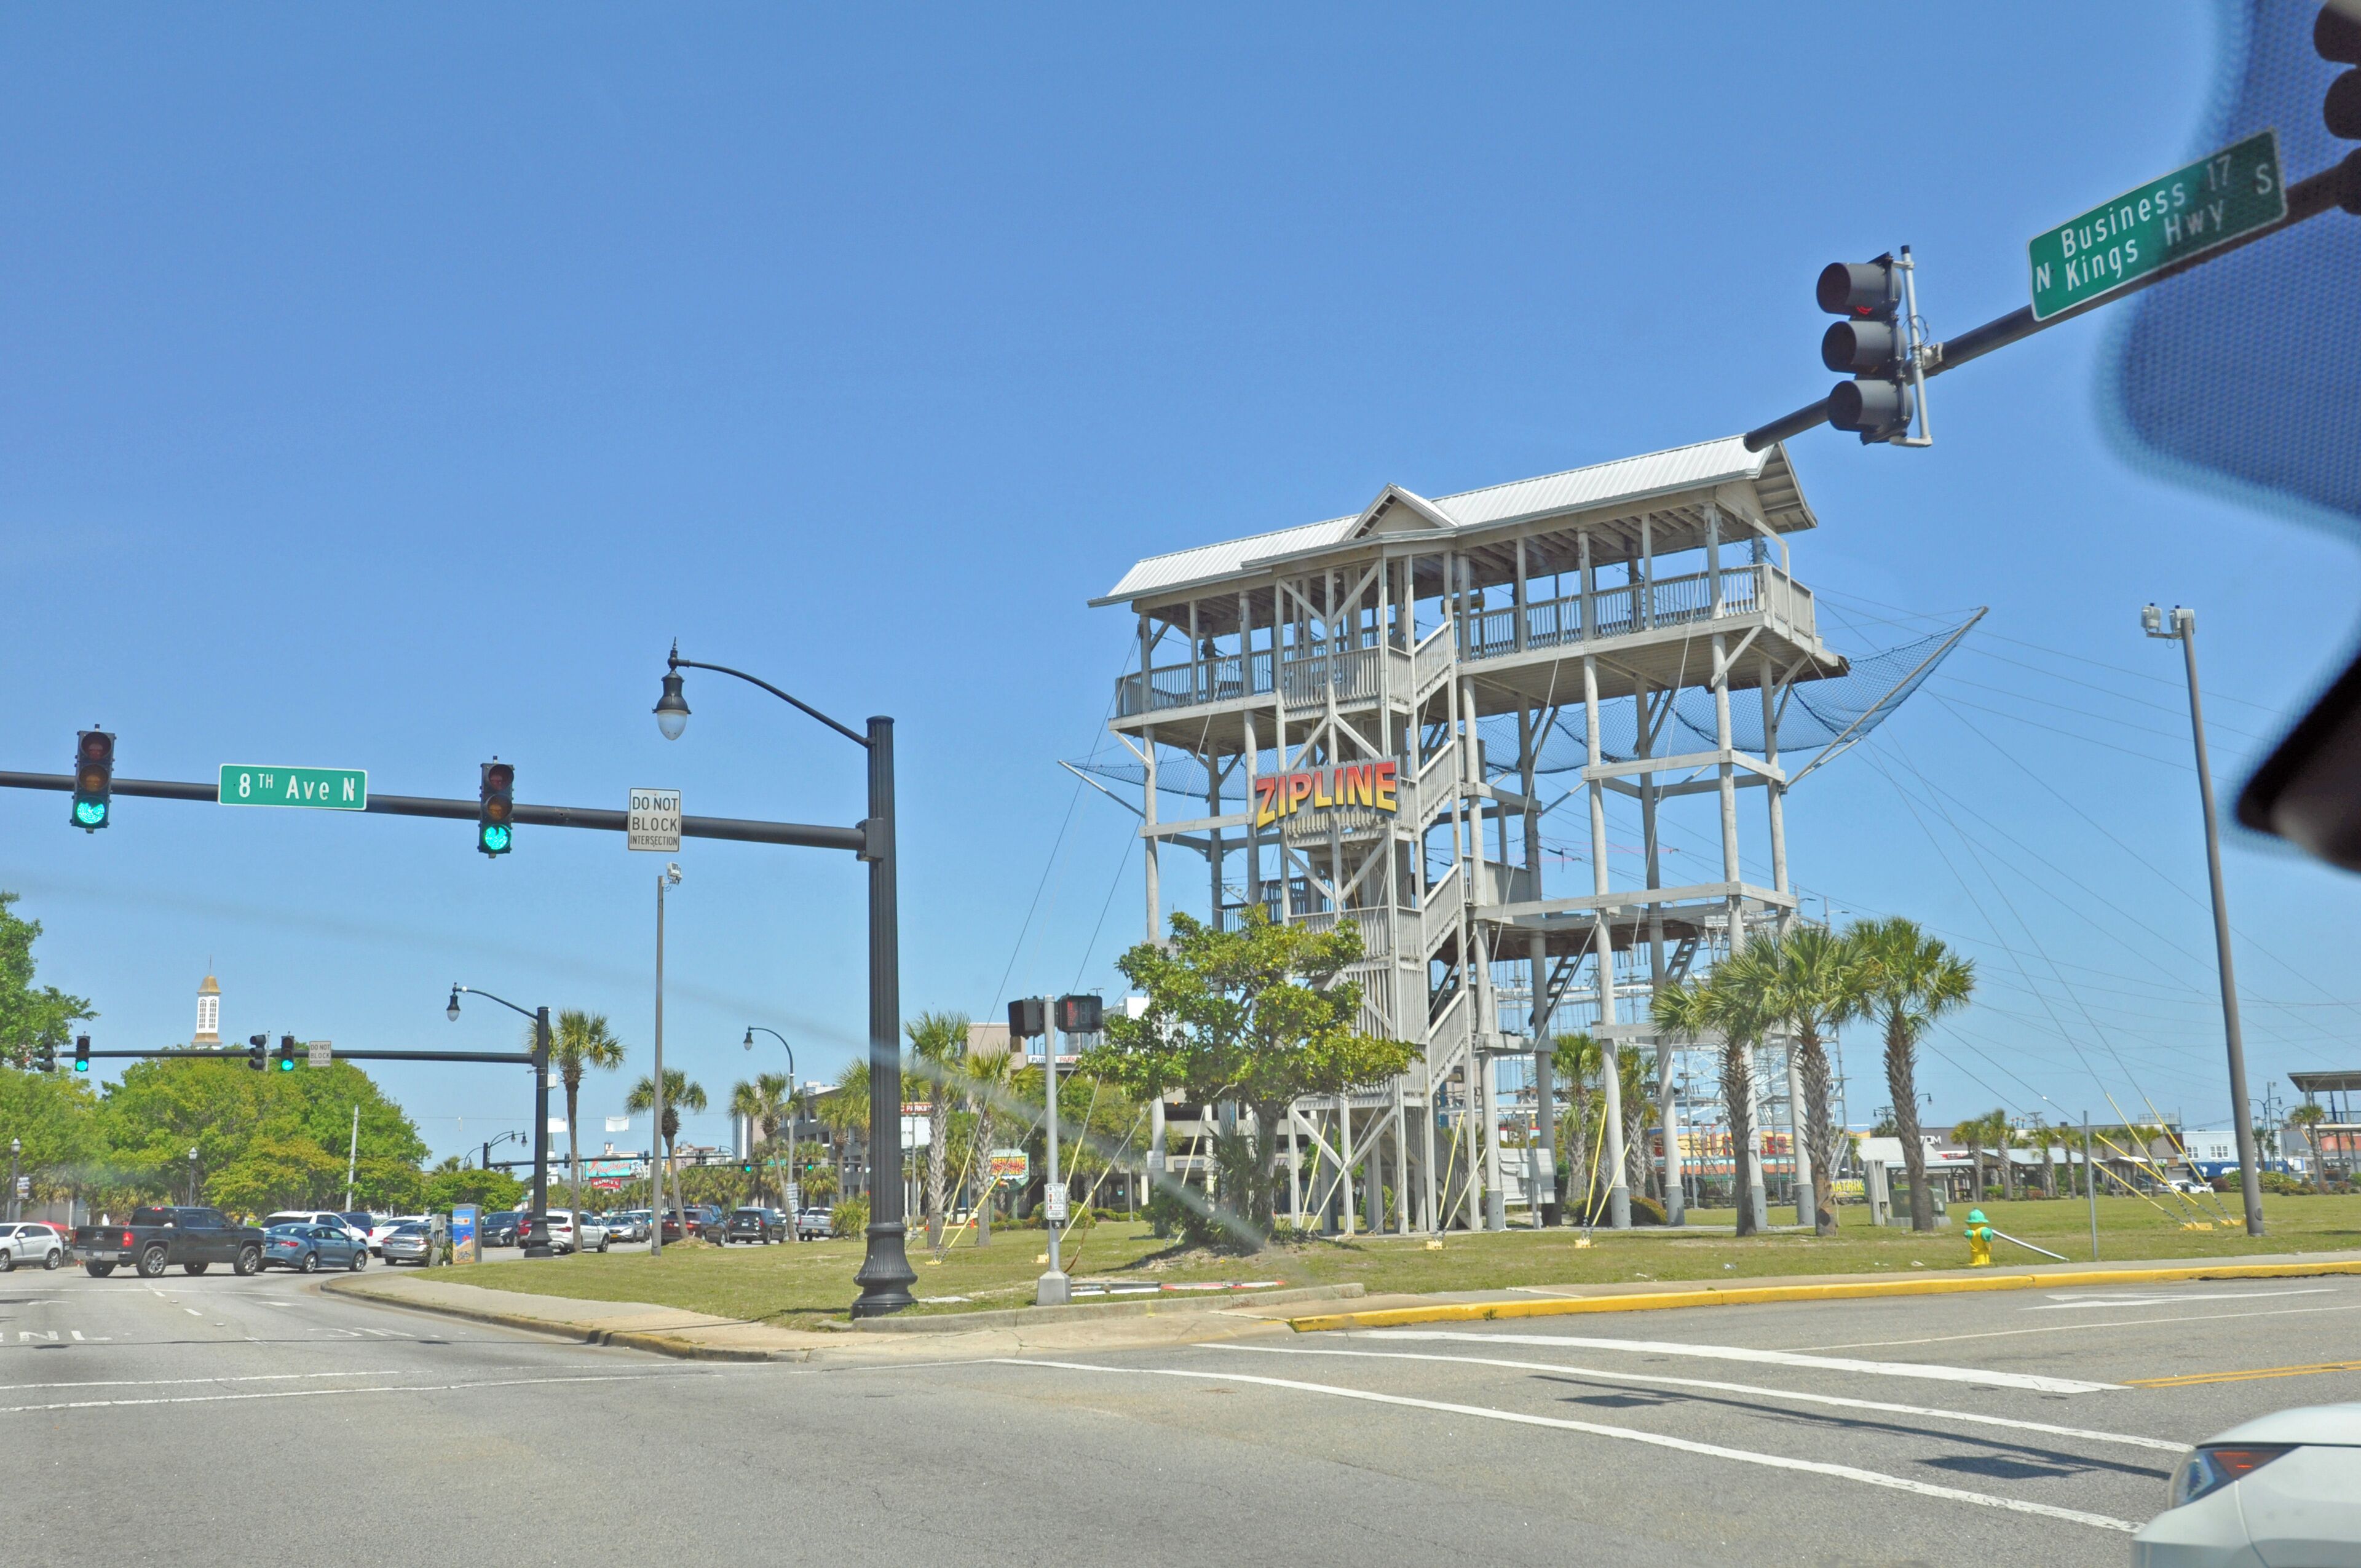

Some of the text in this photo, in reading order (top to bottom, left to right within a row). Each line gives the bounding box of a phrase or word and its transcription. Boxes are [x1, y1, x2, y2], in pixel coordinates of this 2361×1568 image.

[2061, 154, 2232, 259] Business 17
[2036, 163, 2273, 293] N Kings Hwy S
[285, 775, 330, 801] Ave
[342, 777, 355, 801] N
[1256, 761, 1397, 829] ZIPLINE
[633, 796, 678, 811] DO NOT
[632, 817, 678, 832] BLOCK
[630, 835, 678, 846] INTERSECTION
